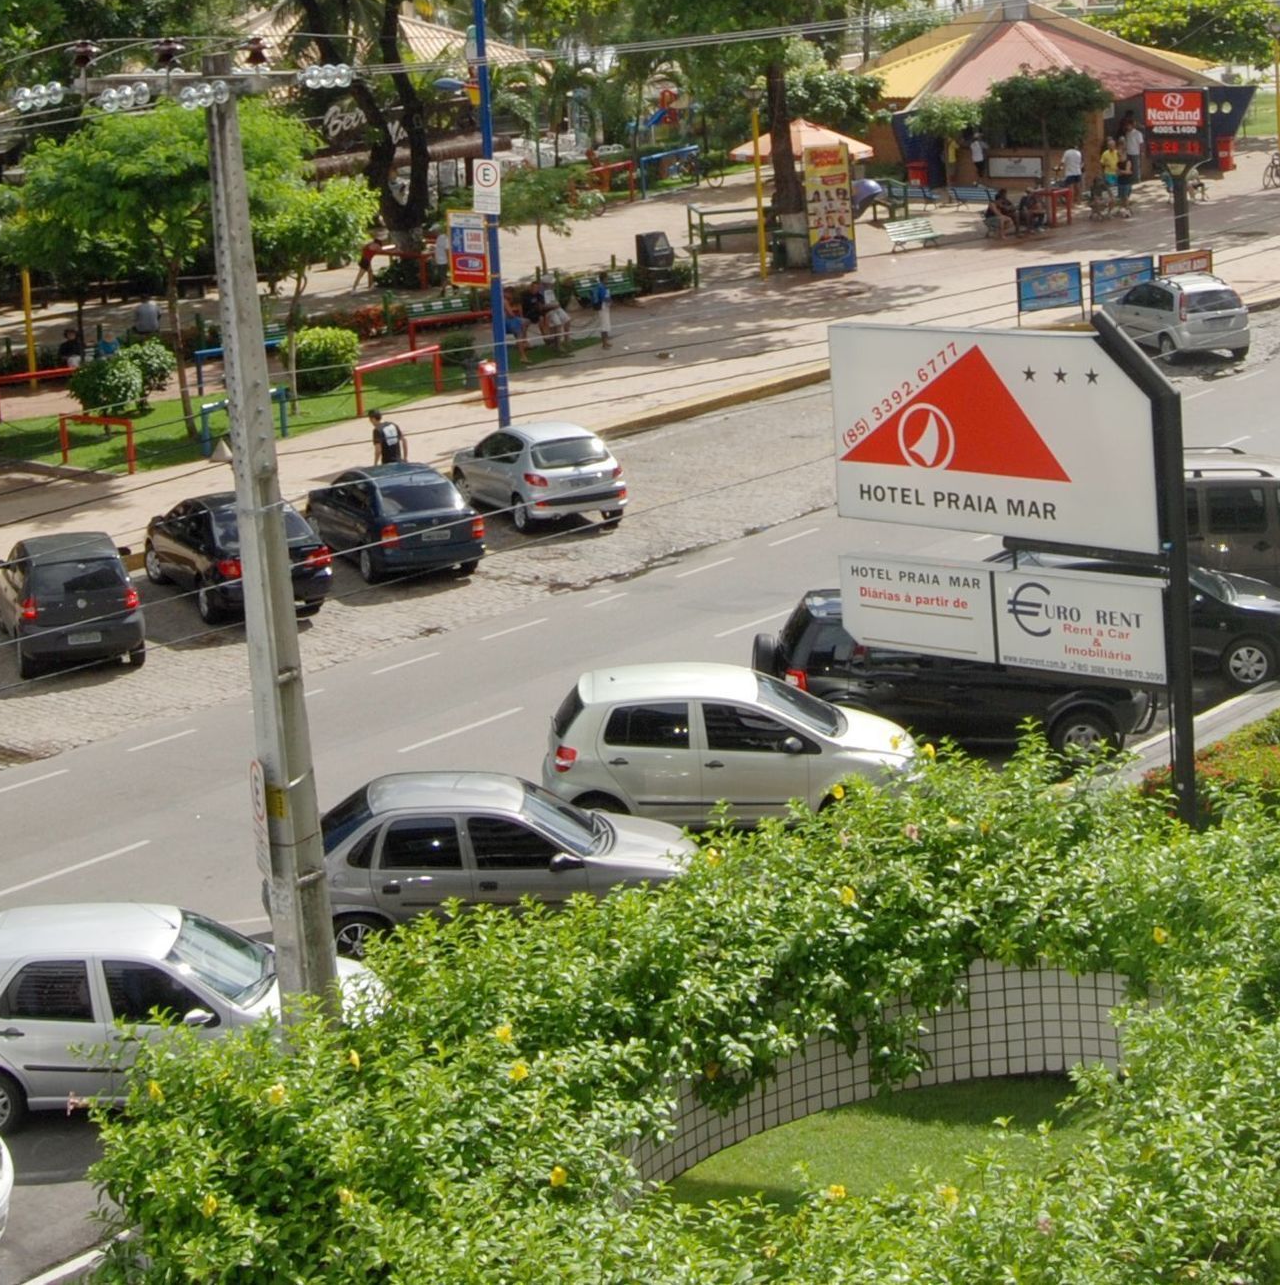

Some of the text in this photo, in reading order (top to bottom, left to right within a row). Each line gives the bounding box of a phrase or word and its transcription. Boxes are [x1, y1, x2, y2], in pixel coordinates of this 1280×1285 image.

[1147, 107, 1200, 120] Newland
[482, 168, 491, 181] E
[842, 342, 958, 448] (85) 3392.6777
[859, 484, 1057, 520] HOTEL PRAIA MAR
[851, 565, 981, 589] HOTEL PRAIA MAR
[859, 586, 901, 602] Diárias
[915, 594, 949, 607] partir
[953, 598, 968, 609] de
[1096, 609, 1144, 629] RENT
[1062, 623, 1093, 636] Rent
[1108, 628, 1131, 640] Car
[1093, 637, 1102, 647] &
[1064, 645, 1132, 662] Imobiliária
